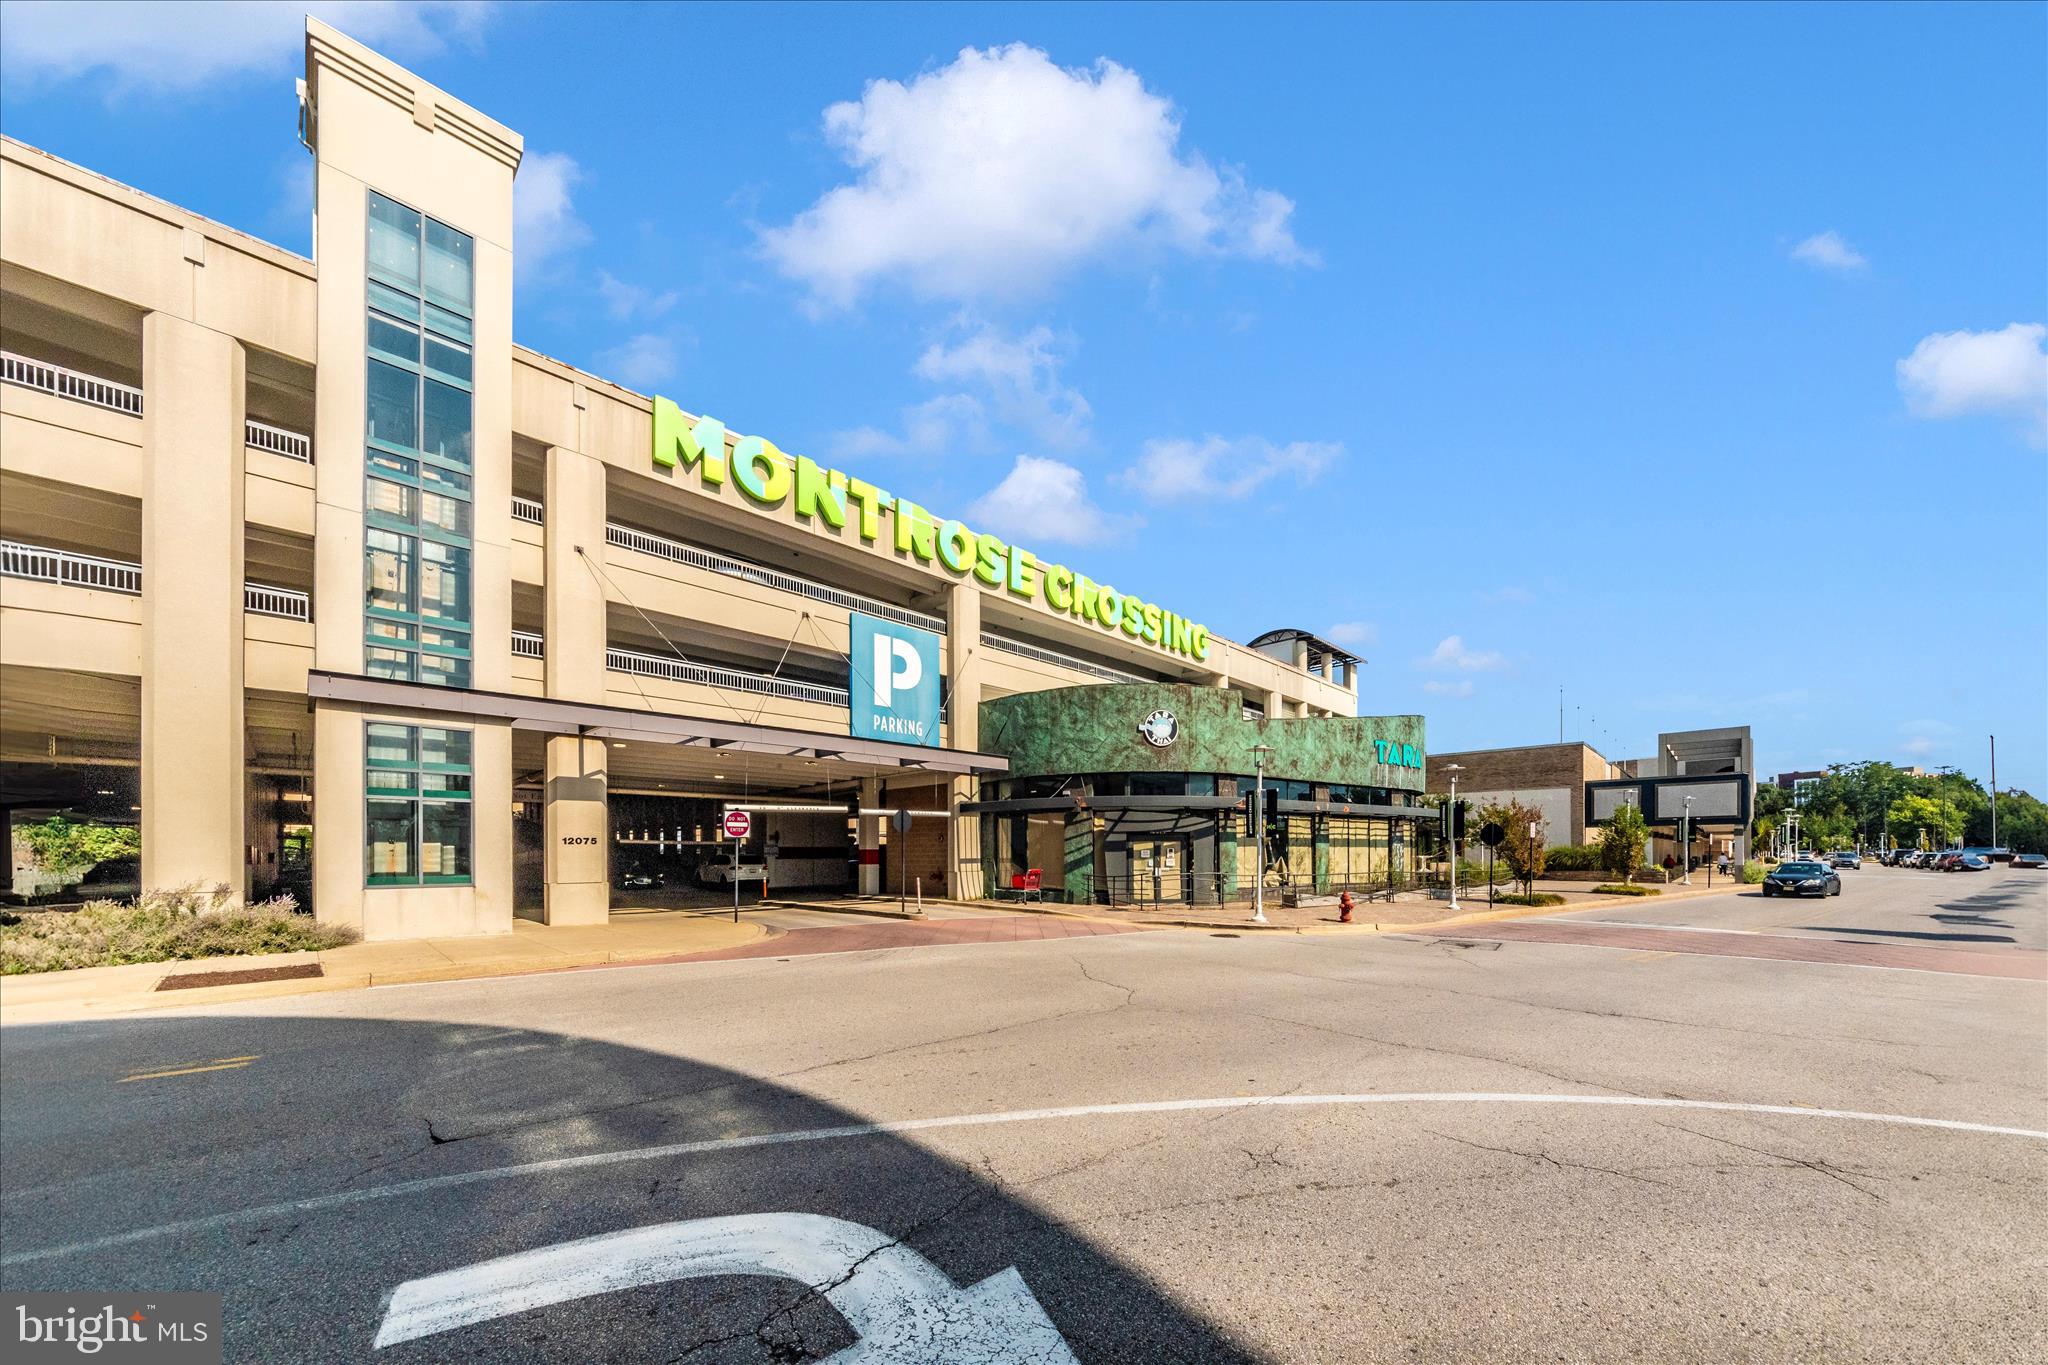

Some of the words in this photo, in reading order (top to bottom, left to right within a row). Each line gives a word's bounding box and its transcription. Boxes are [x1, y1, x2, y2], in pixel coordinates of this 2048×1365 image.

[652, 394, 1037, 598] MONTROSE
[1044, 564, 1210, 661] CROSSING
[873, 632, 922, 708] P
[873, 714, 924, 737] PARKING
[1148, 711, 1175, 725] TARA
[1151, 734, 1172, 745] THAI
[1374, 739, 1423, 769] TARA
[562, 837, 597, 845] 12075
